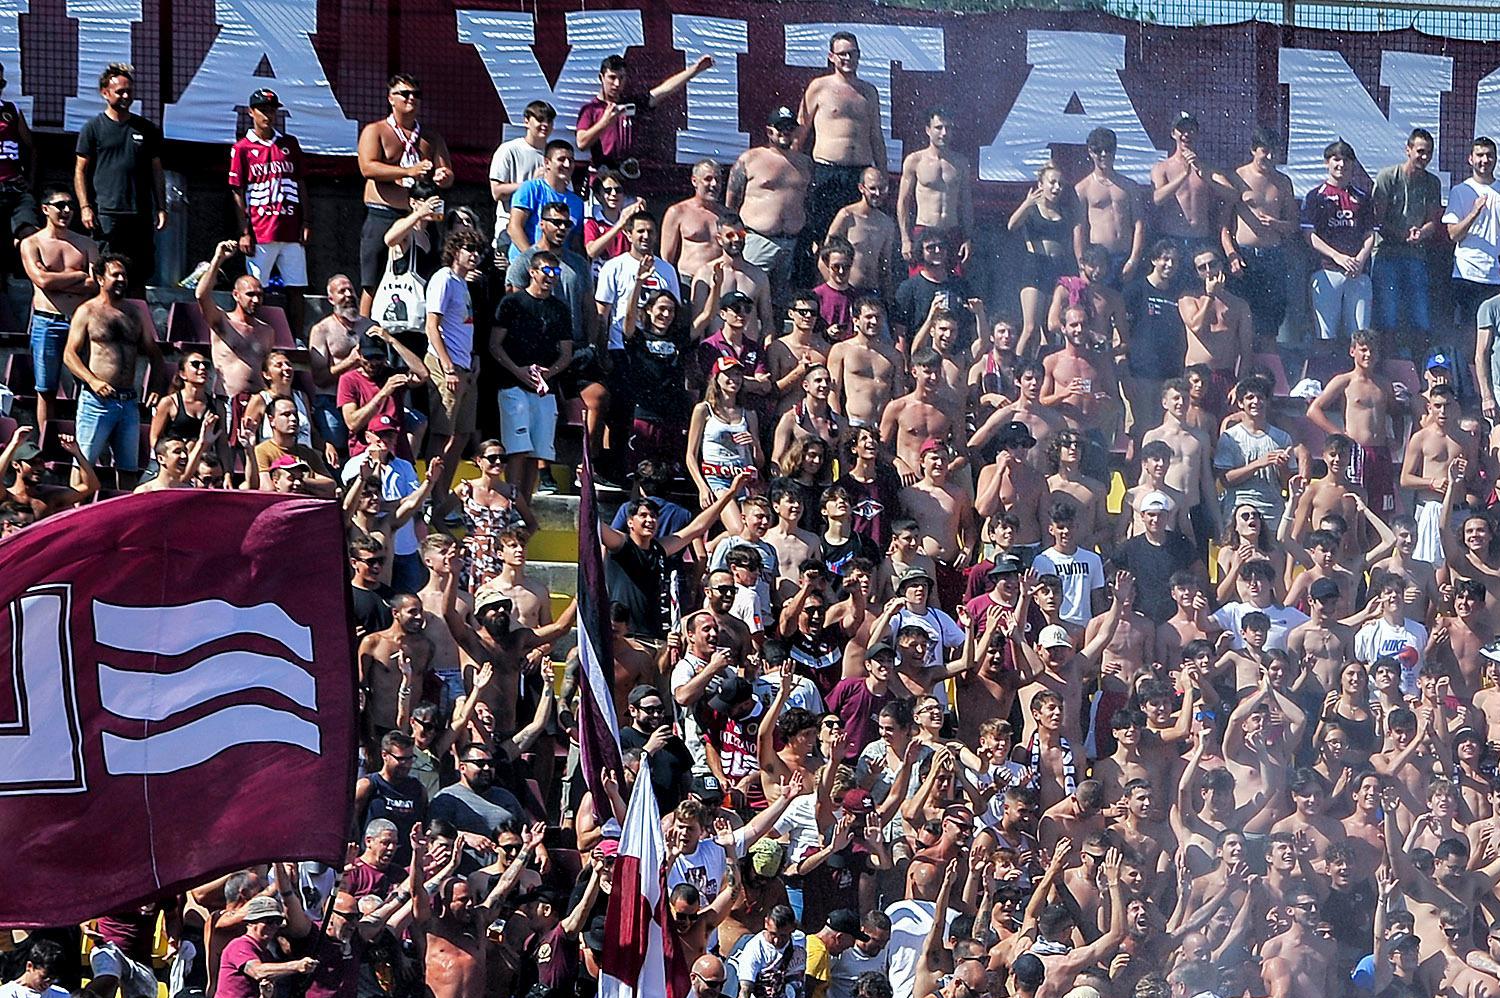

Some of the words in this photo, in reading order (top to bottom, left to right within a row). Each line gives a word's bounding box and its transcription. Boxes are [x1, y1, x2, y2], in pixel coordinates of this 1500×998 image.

[456, 8, 1169, 186] VITA
[1056, 561, 1089, 576] PUMA
[1381, 639, 1408, 652] NIKE
